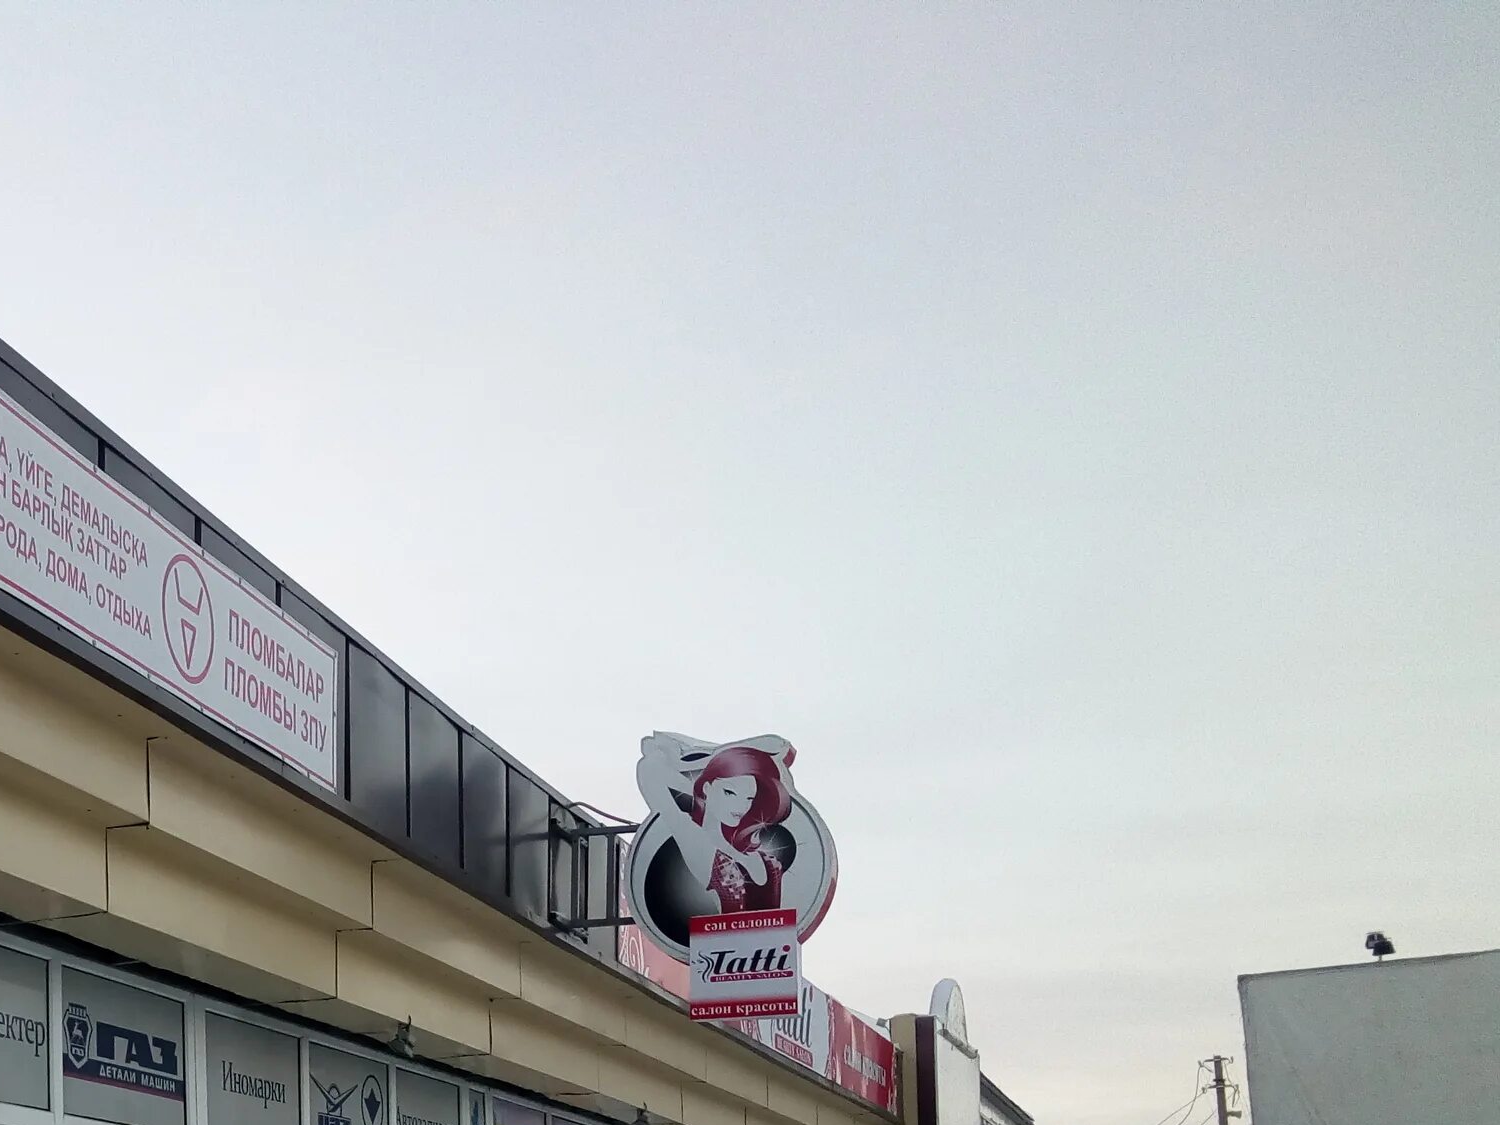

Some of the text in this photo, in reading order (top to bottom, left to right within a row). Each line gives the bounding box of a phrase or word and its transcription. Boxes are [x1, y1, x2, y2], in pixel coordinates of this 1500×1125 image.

[11, 479, 74, 552] БАРЛЫҚ
[77, 528, 127, 580] ЗАТТАР
[17, 447, 57, 506] ҮЙГЕ,
[60, 483, 148, 568] ДЕМАЛЫСҚА
[45, 548, 92, 605] ДОМА,
[95, 583, 152, 640] ОТДЫХА
[228, 608, 325, 703] ПЛОМБАЛАР
[224, 656, 327, 753] ПЛОМБЫ ЗПУ
[731, 917, 784, 929] салоны
[710, 944, 791, 975] Tatti
[691, 1001, 796, 1016] салон красоты
[97, 1021, 179, 1076] ГАЗ
[99, 1064, 176, 1093] ДЕТАЛИ МАШИН
[221, 1060, 286, 1109] Иномарки
